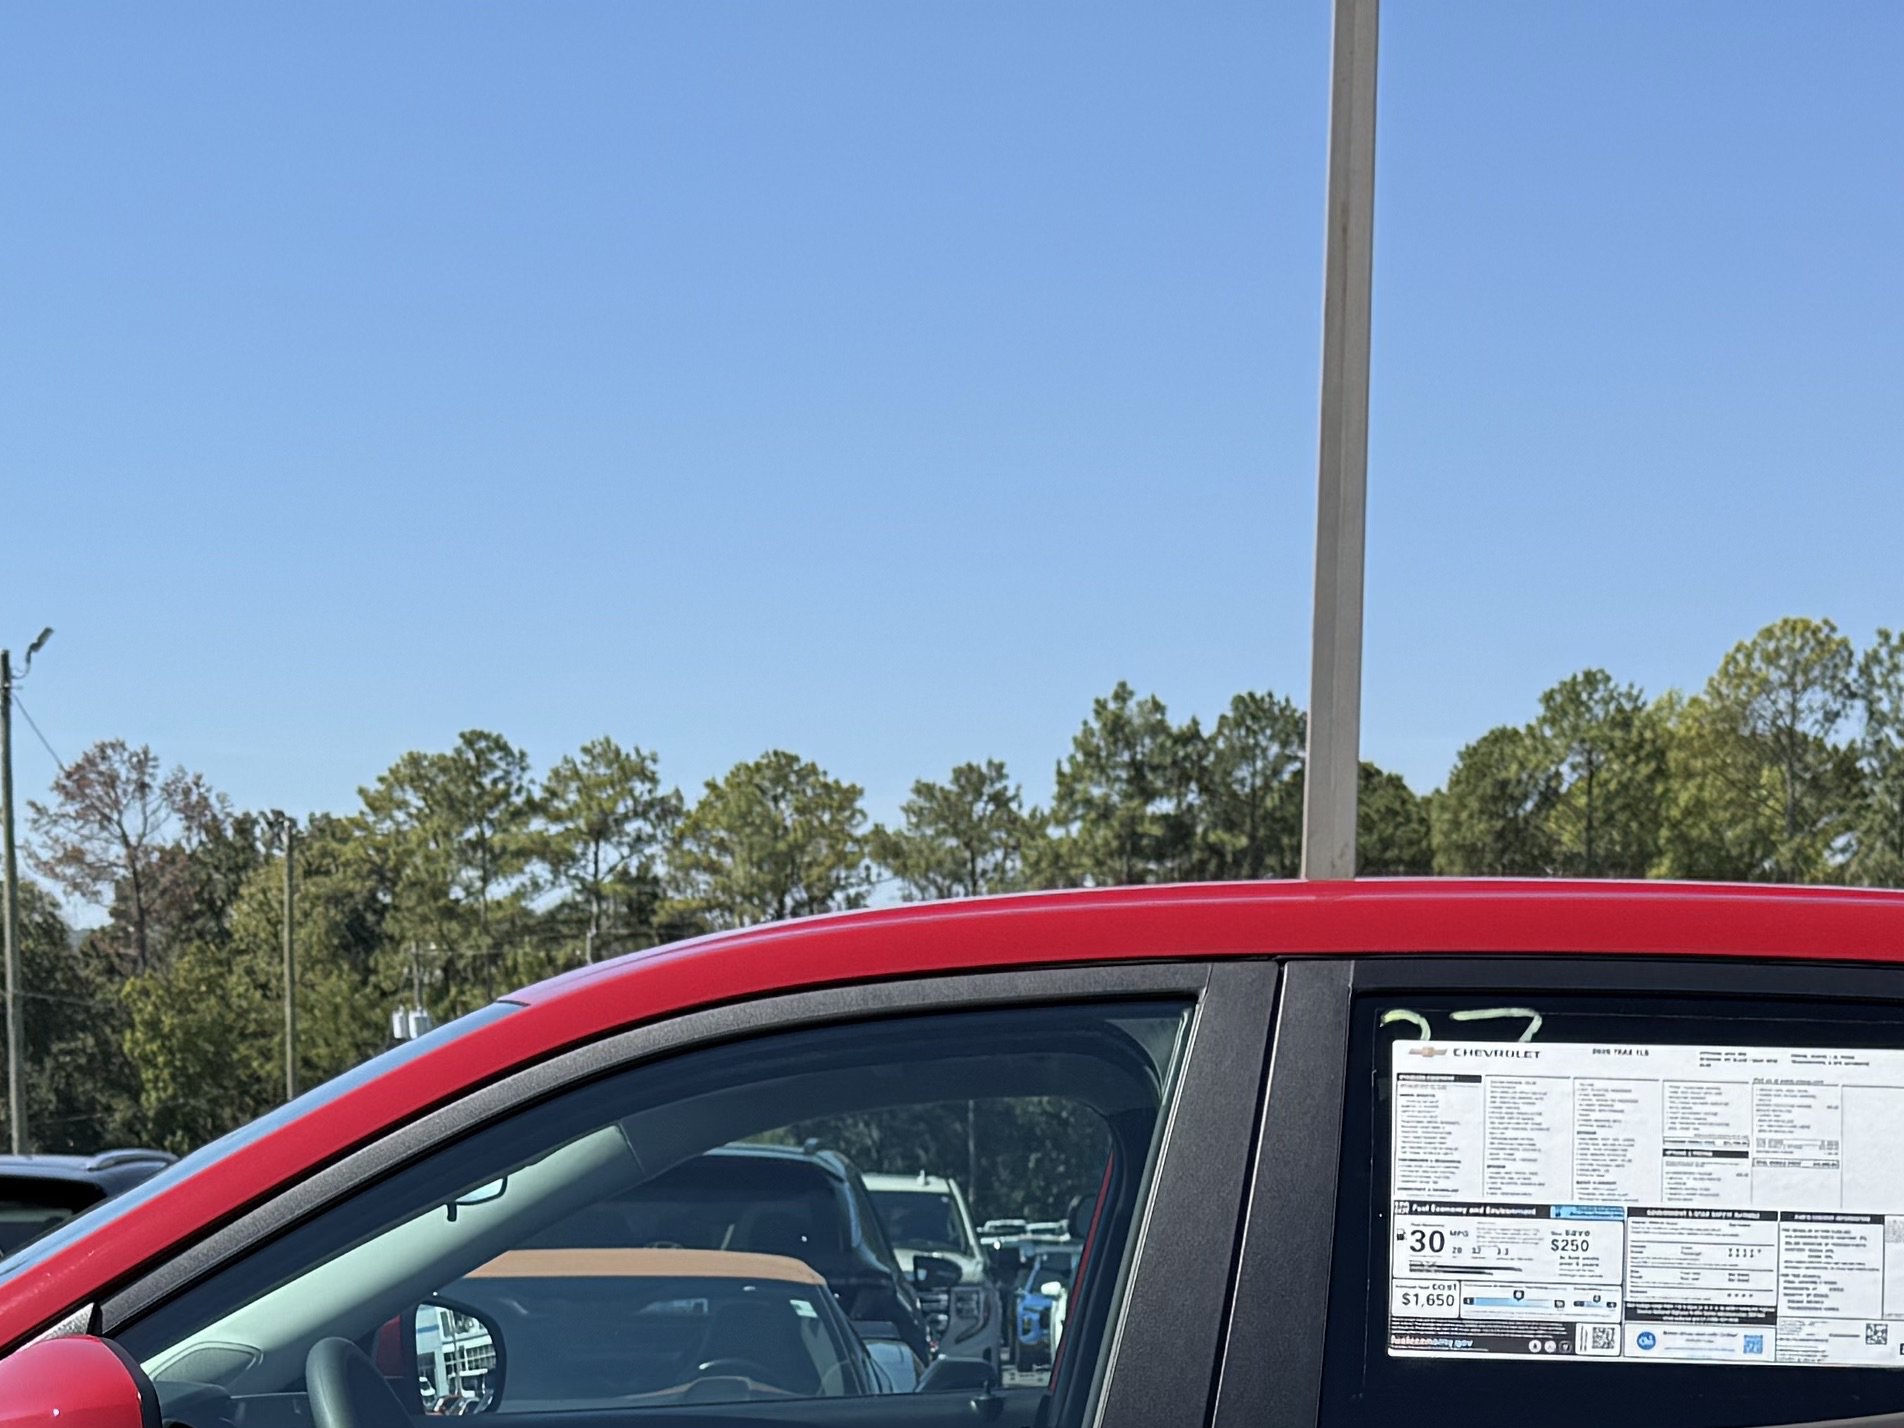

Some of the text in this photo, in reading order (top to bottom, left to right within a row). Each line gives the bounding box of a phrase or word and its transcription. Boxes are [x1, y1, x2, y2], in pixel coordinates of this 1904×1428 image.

[1453, 1048, 1540, 1059] CHEVROLET
[1409, 1229, 1445, 1253] 30
[1551, 1238, 1590, 1252] $250
[1401, 1292, 1455, 1308] $1,650
